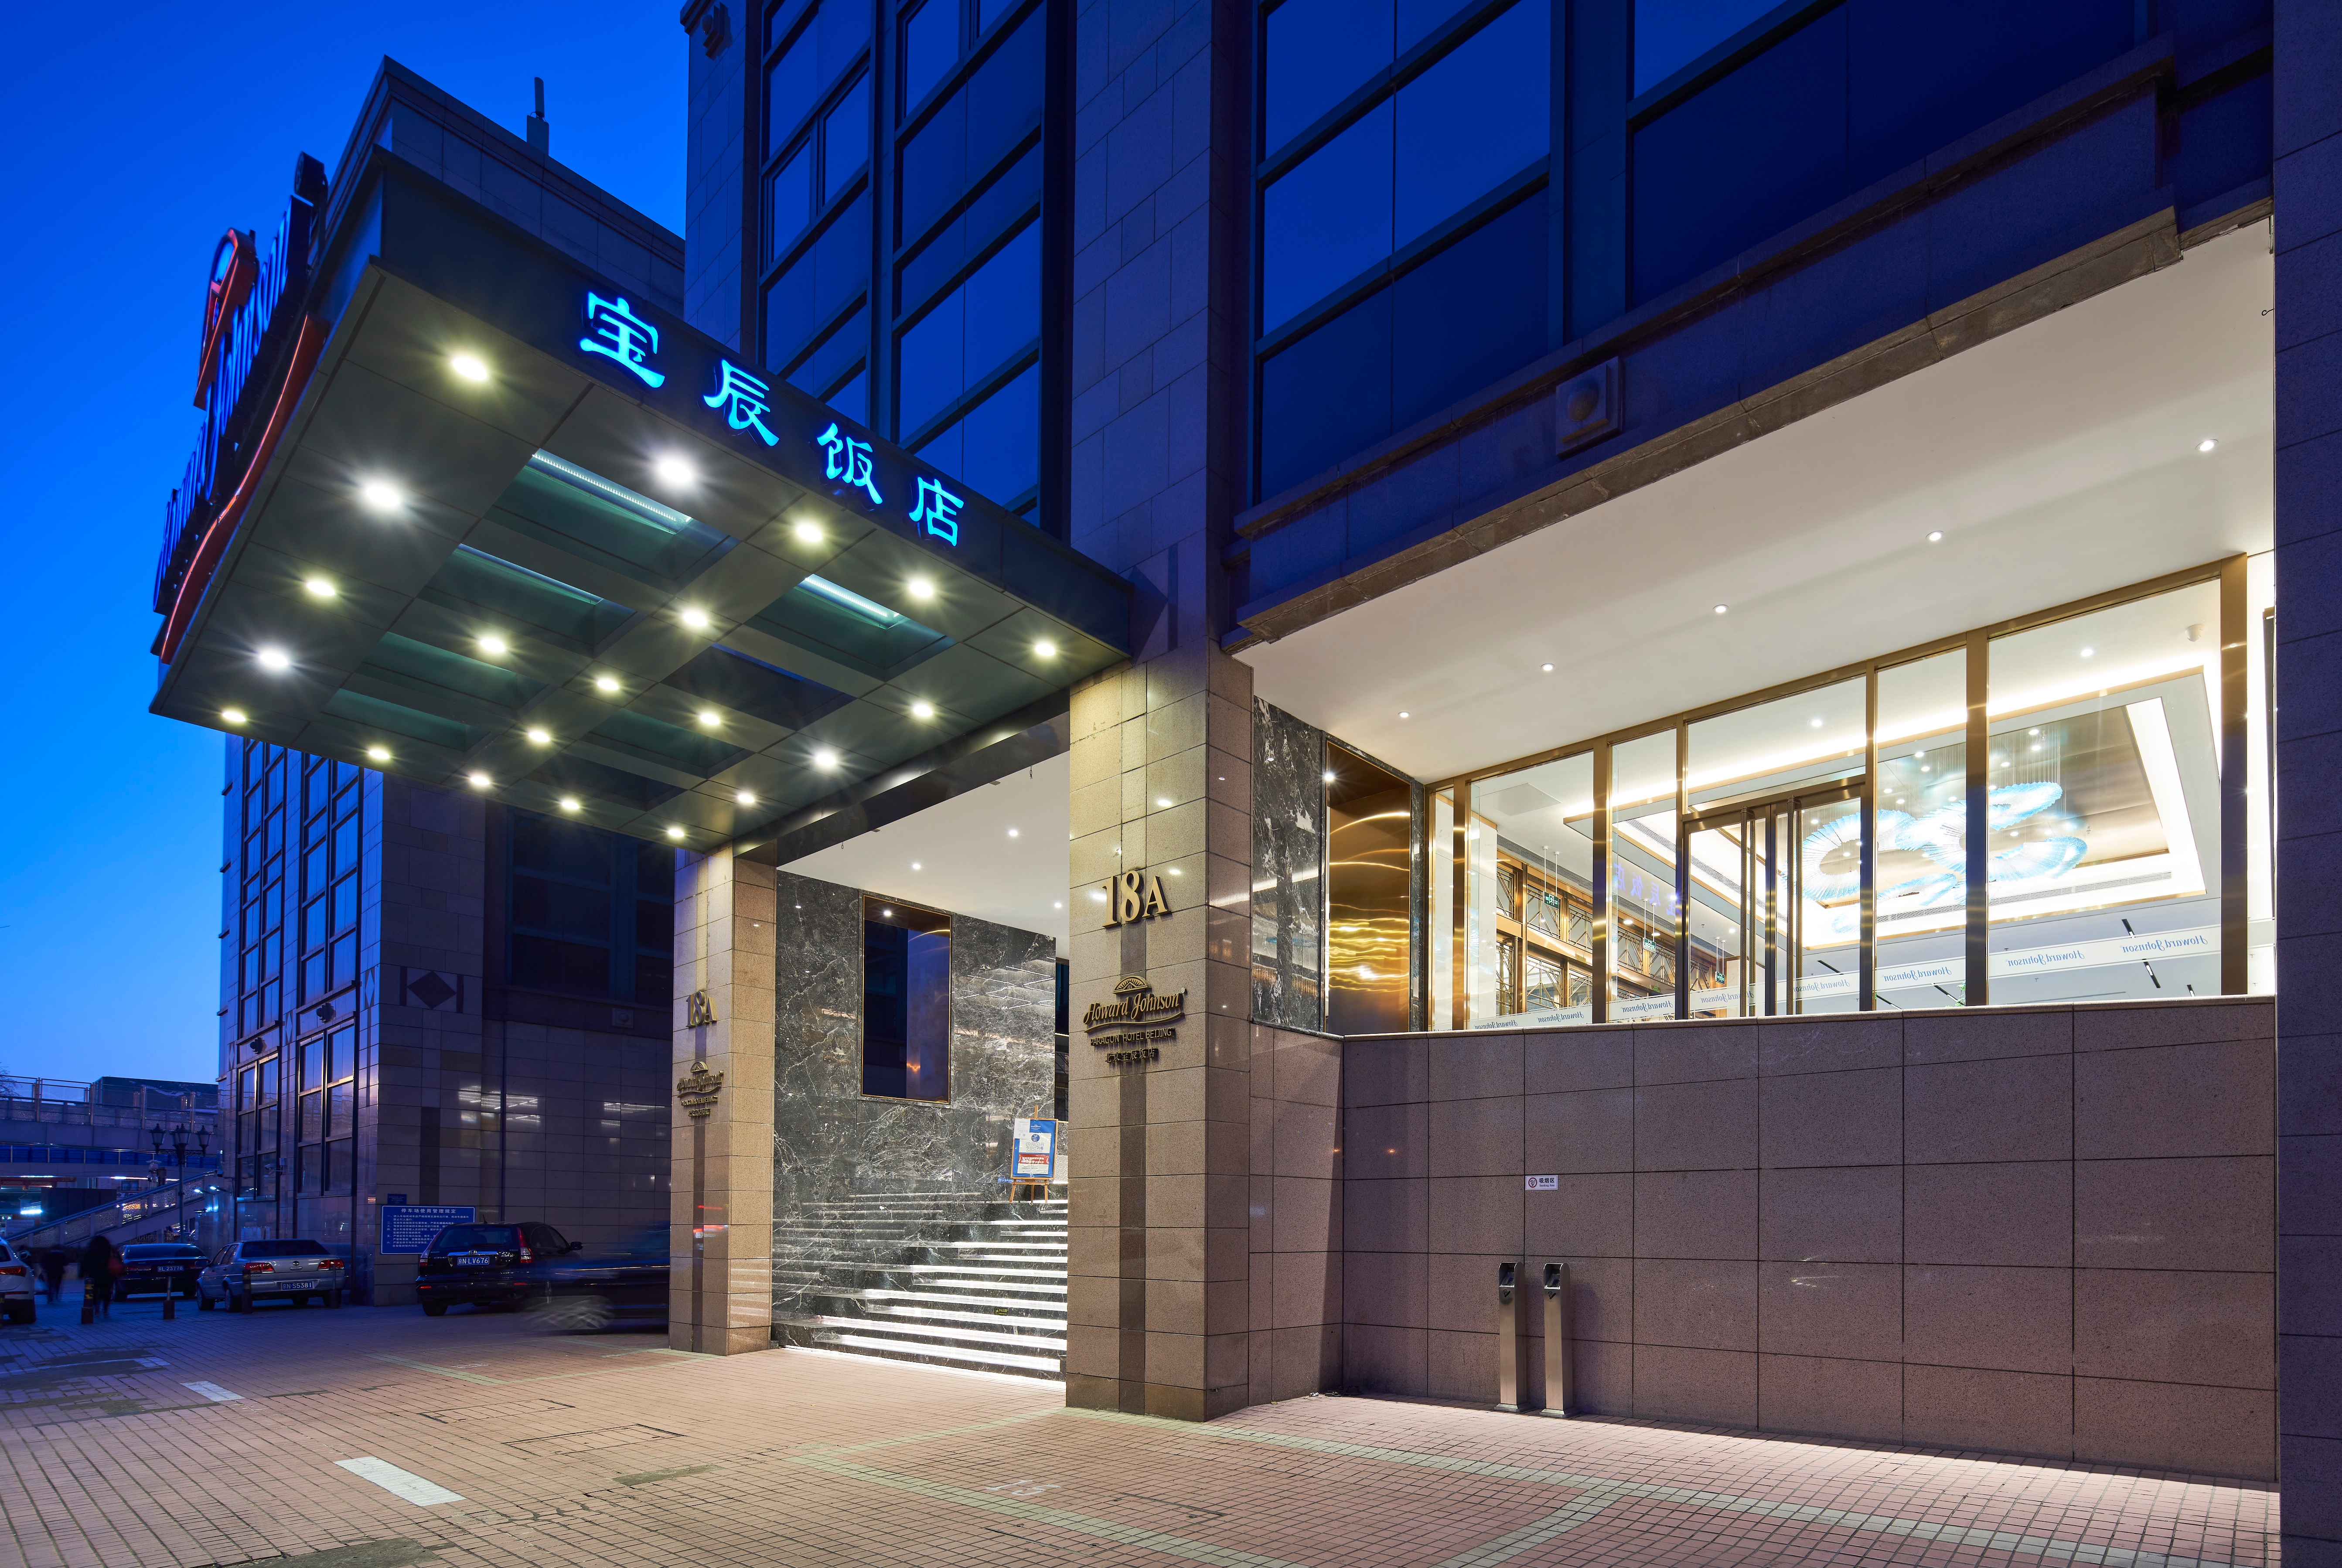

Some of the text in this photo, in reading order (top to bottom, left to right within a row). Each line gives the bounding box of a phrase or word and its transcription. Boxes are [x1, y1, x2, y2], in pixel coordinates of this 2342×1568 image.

[580, 292, 964, 547] 宝辰饭店
[1102, 870, 1170, 928] 18A
[686, 991, 716, 1028] 18A
[1083, 992, 1180, 1025] Howard Johnson
[1090, 1028, 1172, 1046] PARAGON HOTEL BEIJING
[1105, 1048, 1155, 1063] 北京宝辰饭店
